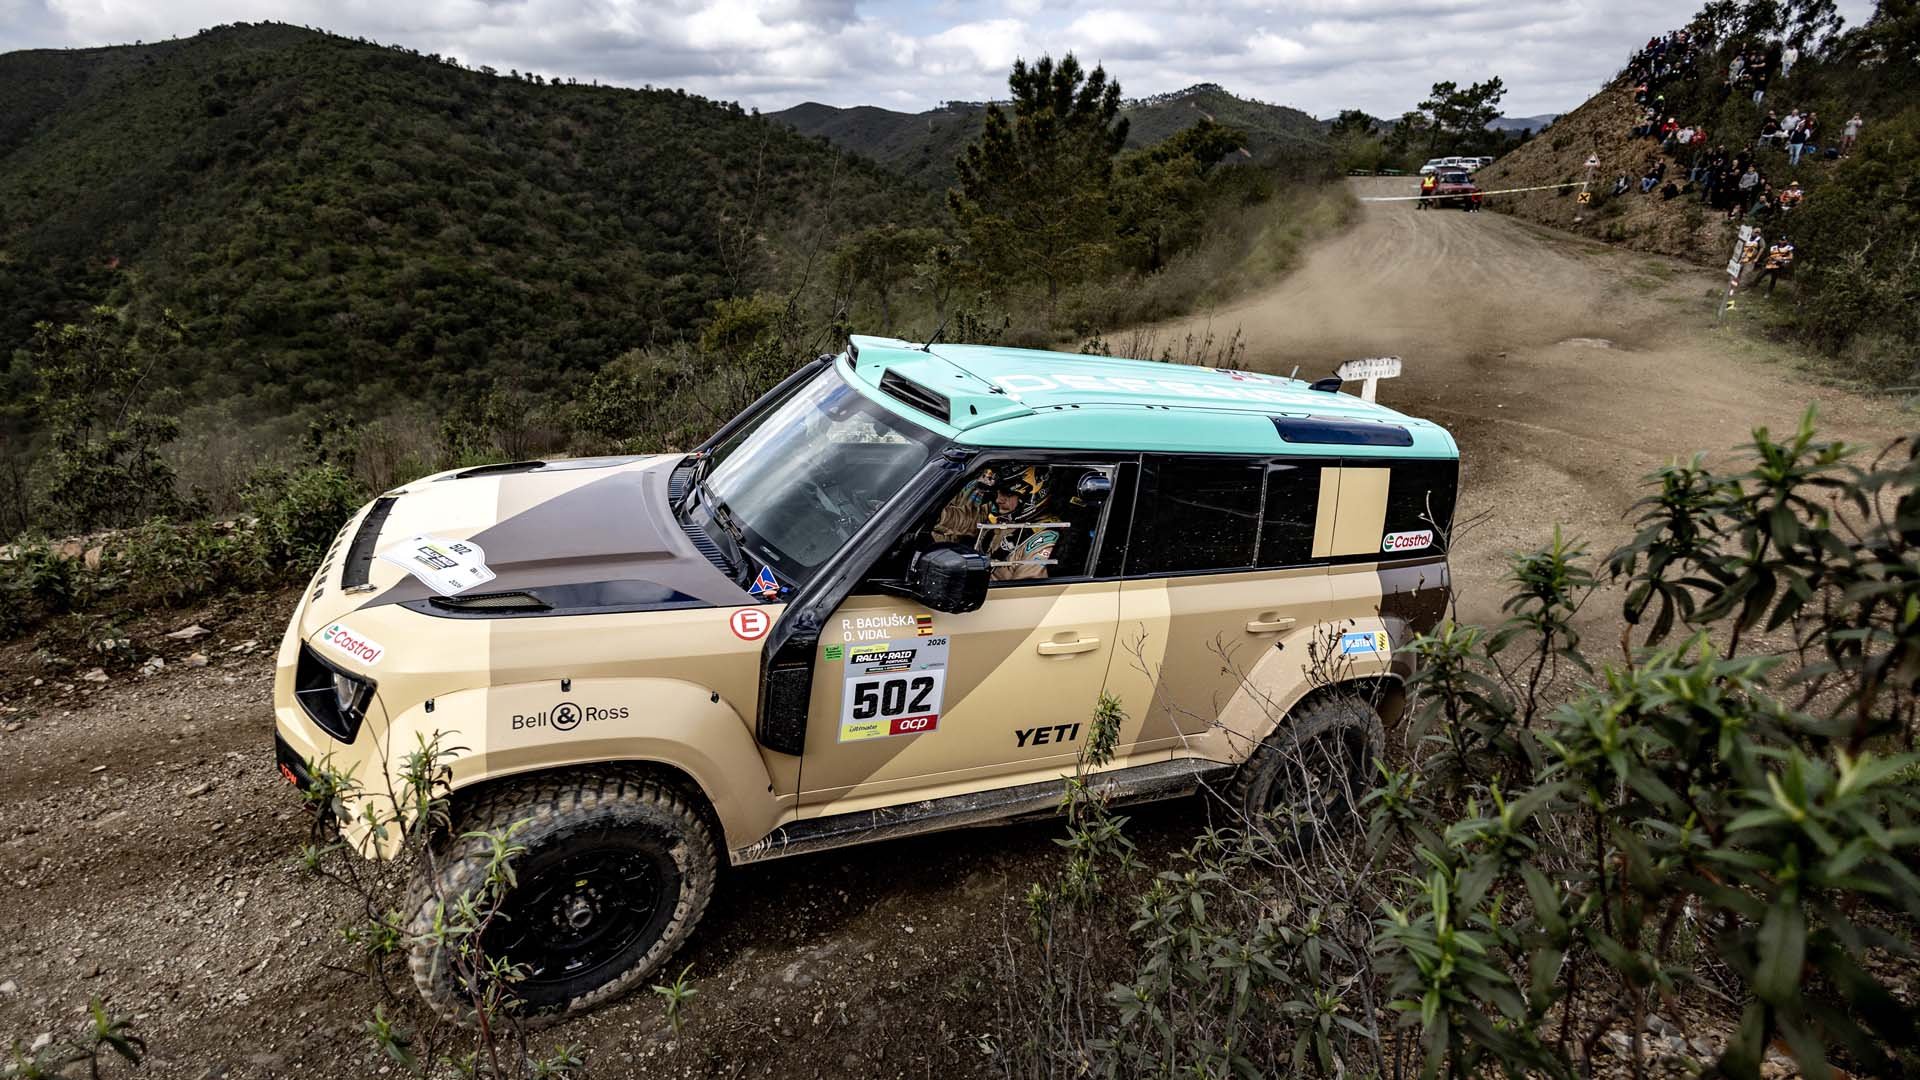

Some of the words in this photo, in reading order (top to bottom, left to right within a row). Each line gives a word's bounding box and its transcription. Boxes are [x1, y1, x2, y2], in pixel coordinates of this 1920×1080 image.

[1394, 533, 1431, 548] Castrol
[449, 543, 472, 555] 502
[740, 612, 760, 633] E
[842, 619, 854, 630] R.
[856, 613, 915, 629] BACIUŠKA
[843, 631, 855, 642] O.
[857, 629, 891, 641] VIDAL
[927, 638, 947, 647] 2026
[334, 631, 382, 663] Castrol
[855, 650, 912, 663] RALLY-RAID
[852, 676, 935, 720] 502
[512, 712, 547, 730] Bell
[586, 706, 629, 722] Ross
[900, 718, 928, 730] acp
[1015, 722, 1080, 748] YETI
